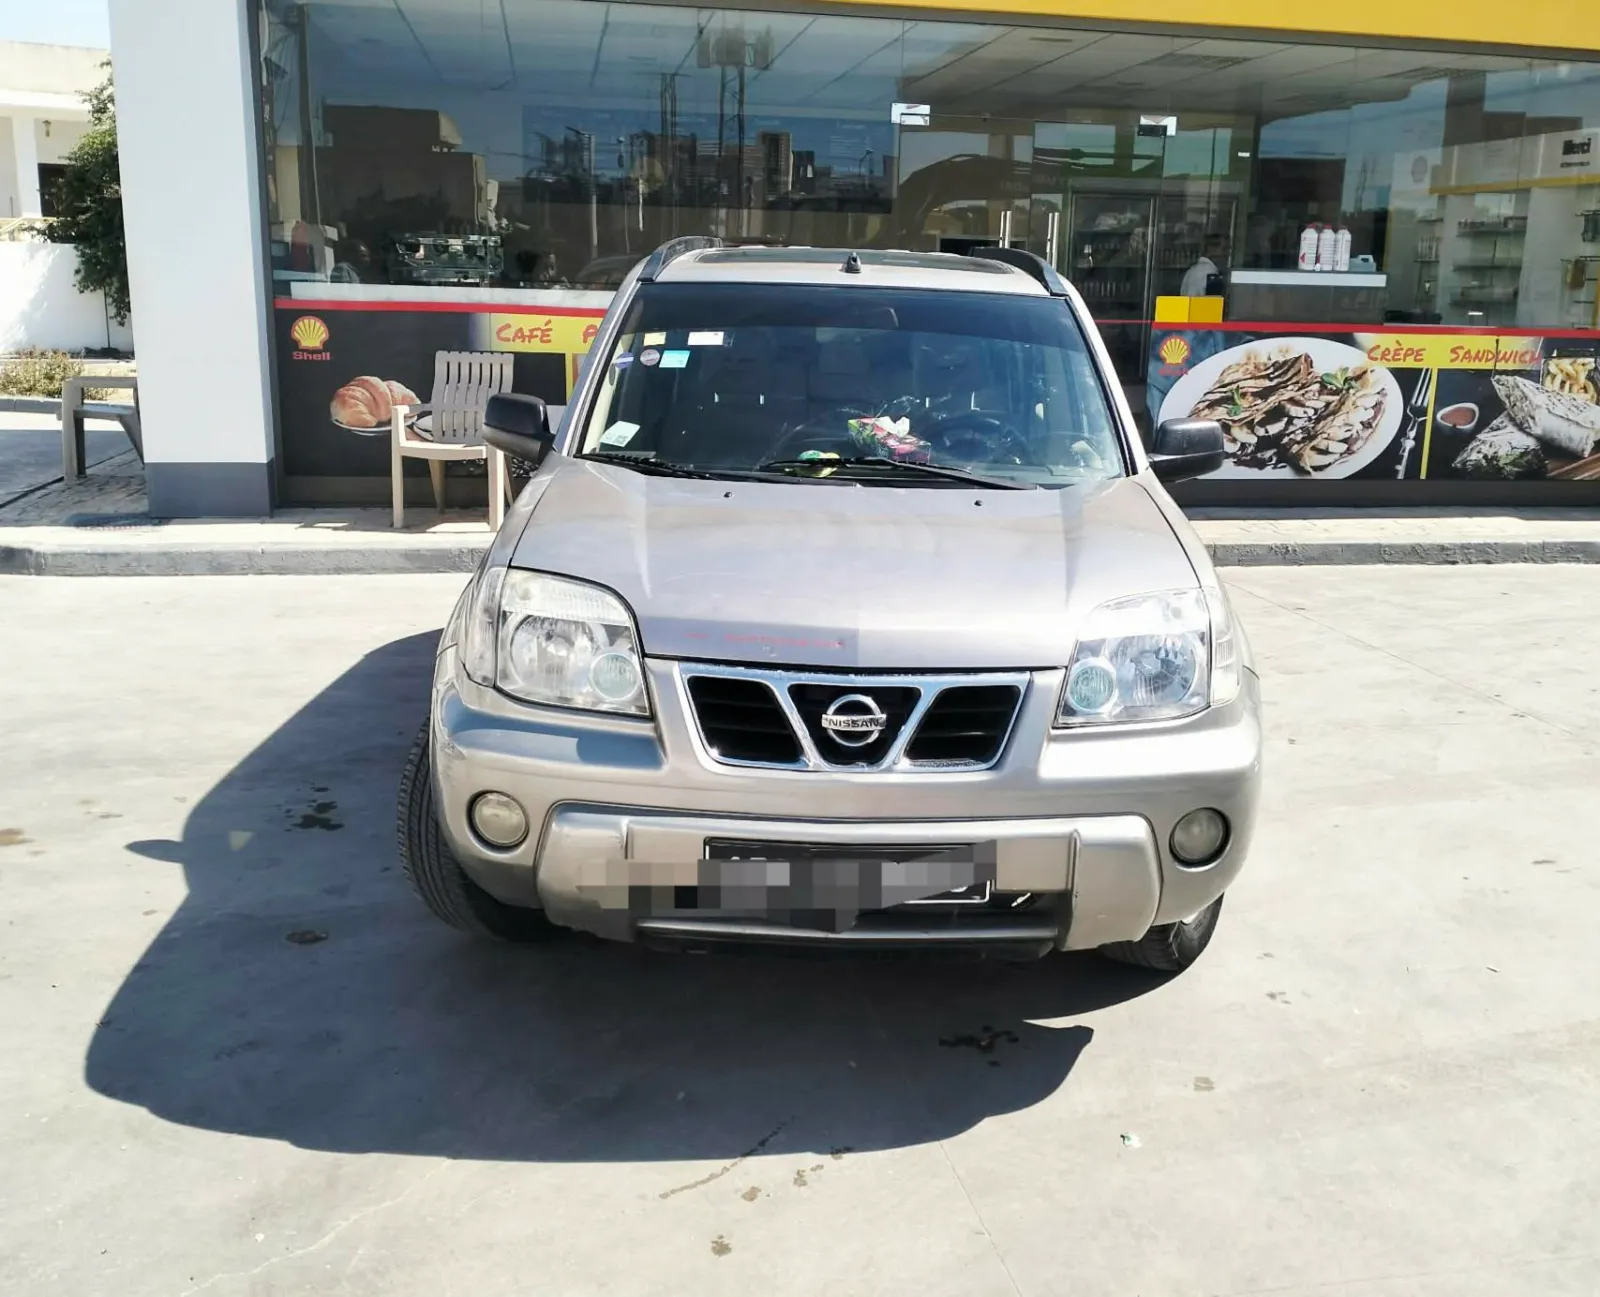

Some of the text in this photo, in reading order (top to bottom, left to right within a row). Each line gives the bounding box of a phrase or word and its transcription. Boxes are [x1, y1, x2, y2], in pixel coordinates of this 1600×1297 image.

[495, 319, 598, 343] CAFÉ P
[292, 351, 331, 361] Shell
[1367, 340, 1541, 365] CRÈPE SANDWICH
[828, 717, 880, 729] NISSAN
